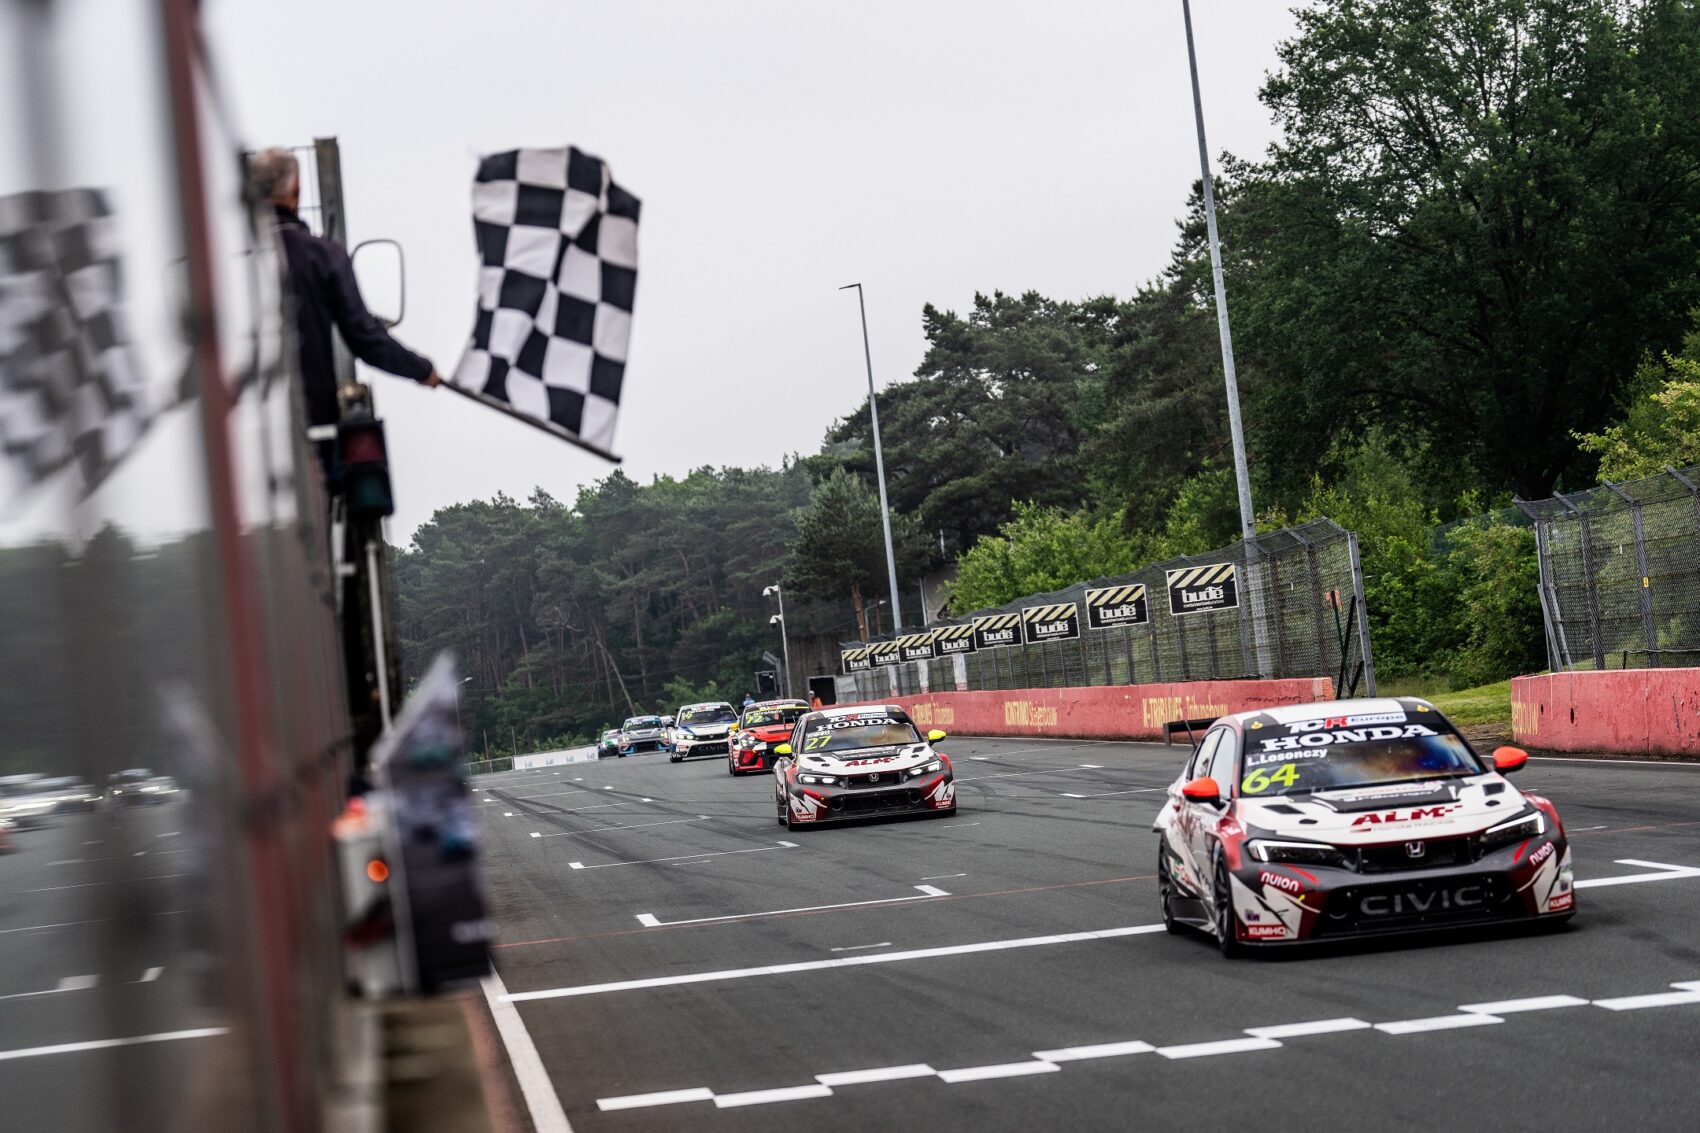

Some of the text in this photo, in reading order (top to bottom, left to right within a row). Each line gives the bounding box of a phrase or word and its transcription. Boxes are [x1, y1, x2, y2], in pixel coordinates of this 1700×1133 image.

[816, 718, 900, 732] HONDA
[1285, 713, 1405, 734] TCR Europe
[804, 735, 832, 750] 27
[1260, 724, 1439, 752] HONDA
[1247, 749, 1328, 767] L.Losonczy
[1241, 763, 1300, 794] 64
[1360, 886, 1482, 915] CIVIC
